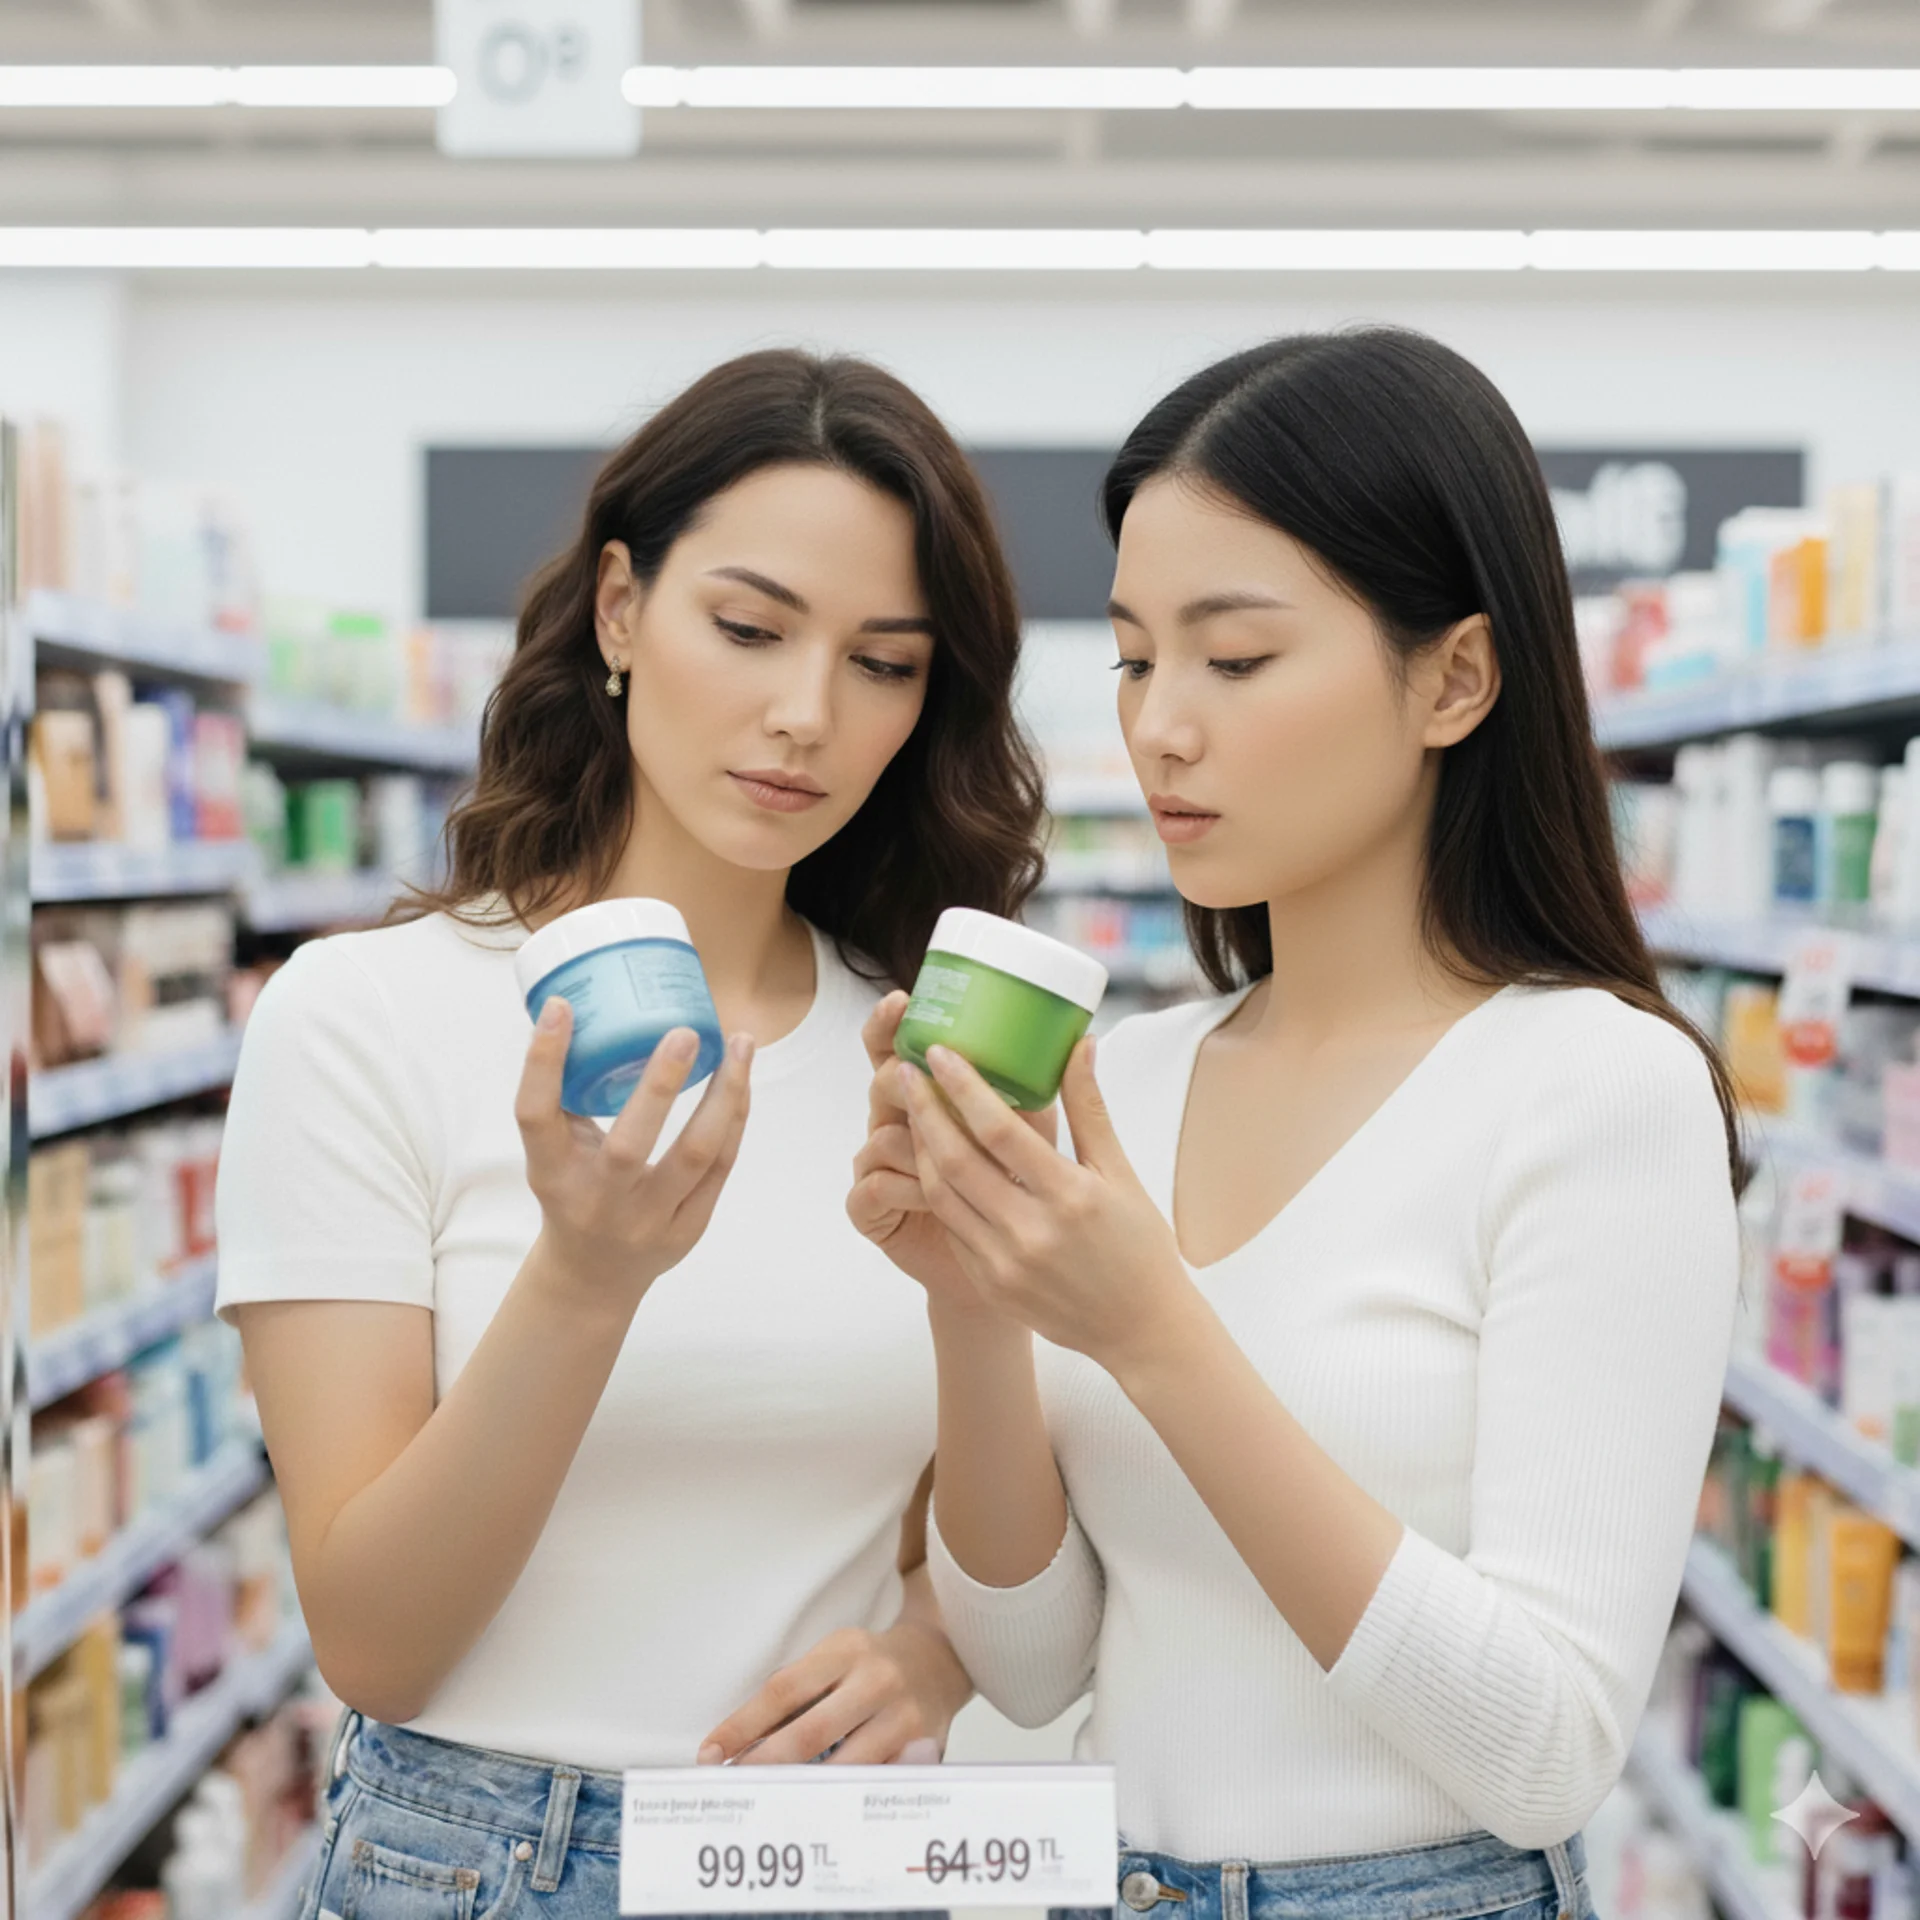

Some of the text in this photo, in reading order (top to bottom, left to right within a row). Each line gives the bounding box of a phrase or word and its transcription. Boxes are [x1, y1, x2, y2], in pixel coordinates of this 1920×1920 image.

[697, 1842, 838, 1891] 99,99 TL
[1037, 1837, 1065, 1862] TL
